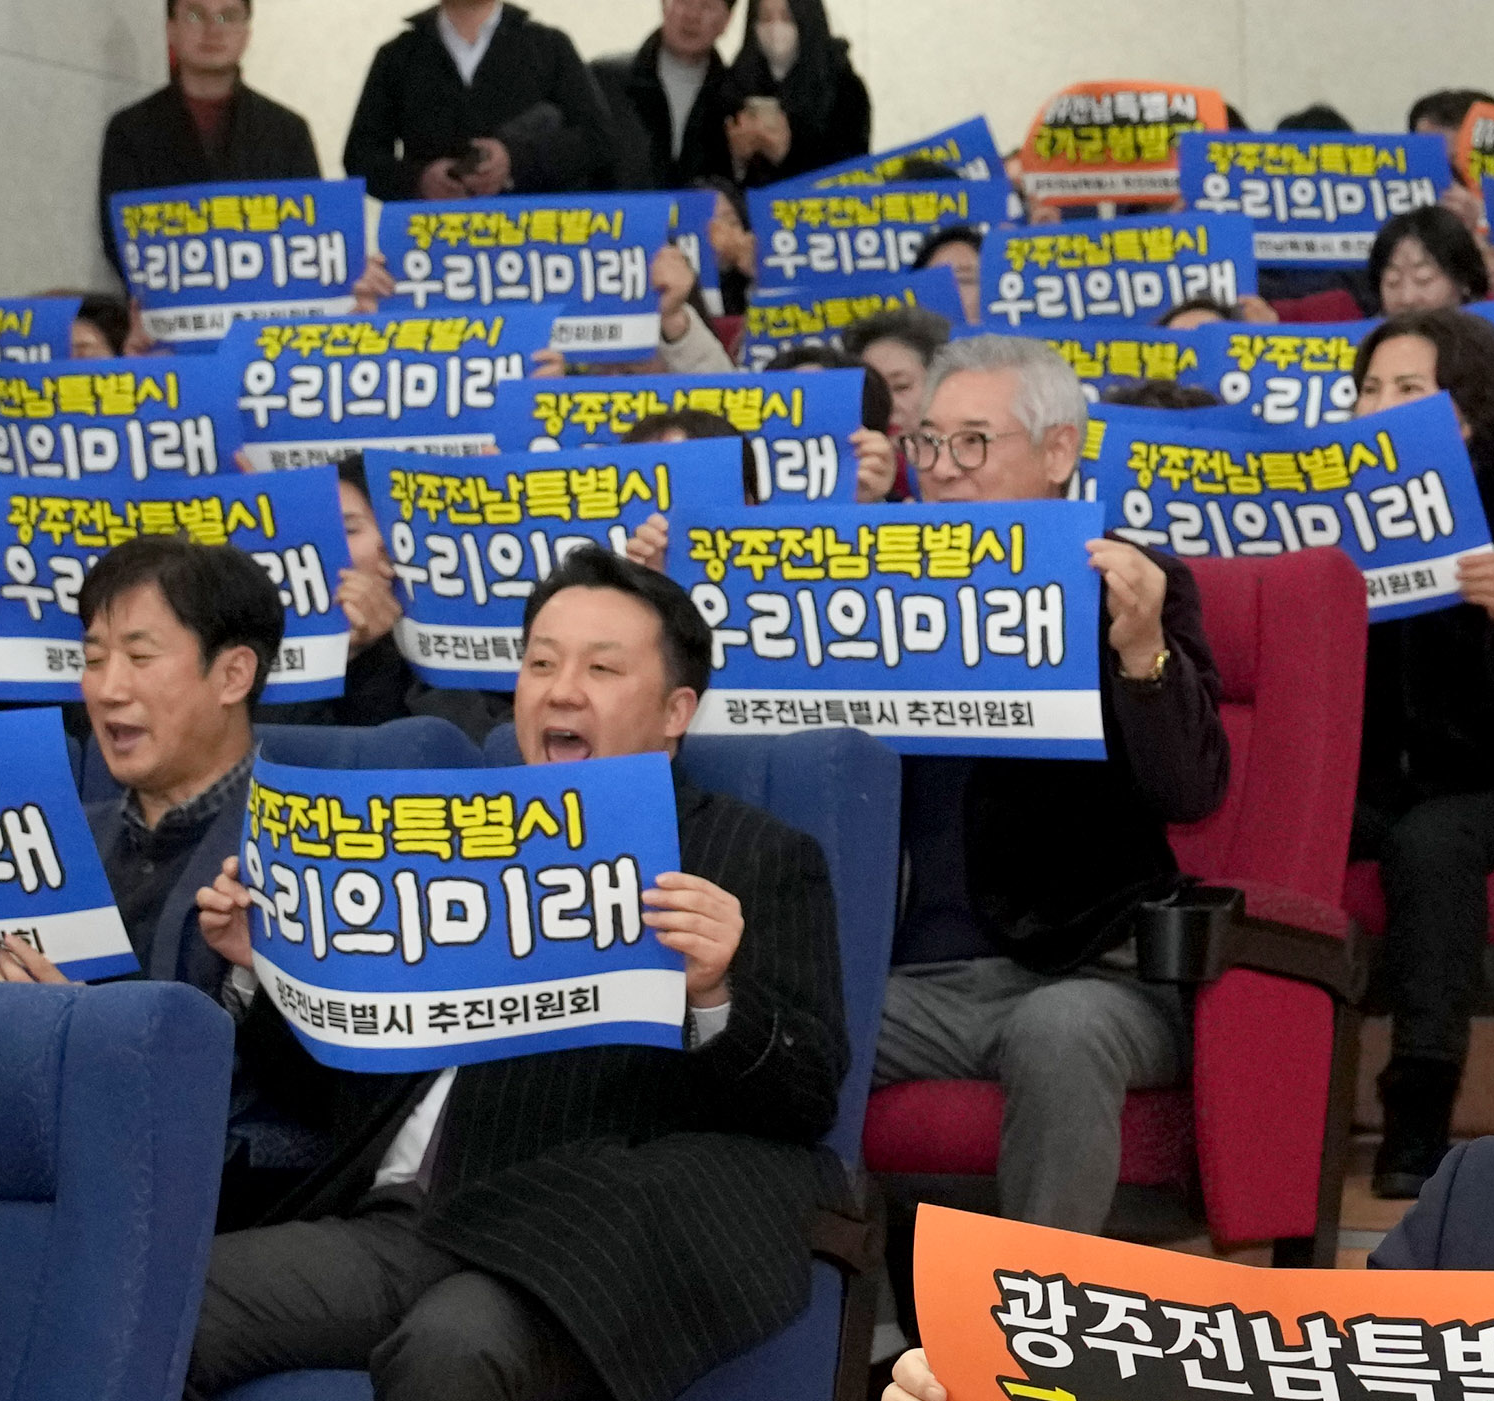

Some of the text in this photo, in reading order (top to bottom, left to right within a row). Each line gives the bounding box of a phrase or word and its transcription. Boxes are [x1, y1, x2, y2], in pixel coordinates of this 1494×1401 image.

[1209, 143, 1406, 175] 광주전남특별시
[123, 195, 315, 238] 광주전남특별시
[773, 193, 967, 230] 광주전남특별시
[1195, 173, 1436, 222] 우리의미래
[408, 210, 622, 249] 광주전남특별시
[1006, 227, 1207, 271] 광주전남특별시
[392, 246, 647, 308] 우리의미래
[989, 260, 1238, 330] 우리의미래
[257, 319, 503, 360] 광주전남특별시
[239, 354, 523, 428] 우리의미래
[1127, 431, 1397, 495] 광주전남특별시
[391, 465, 670, 525] 광주전남특별시
[1115, 470, 1454, 558] 우리의미래
[689, 523, 1023, 582] 광주전남특별시
[690, 583, 1064, 669] 우리의미래
[726, 699, 1034, 728] 광주전남특별시 추진위원회
[249, 790, 582, 860] 광주전남특별시
[245, 840, 641, 964] 우리의미래
[428, 985, 601, 1036] 추진위원회
